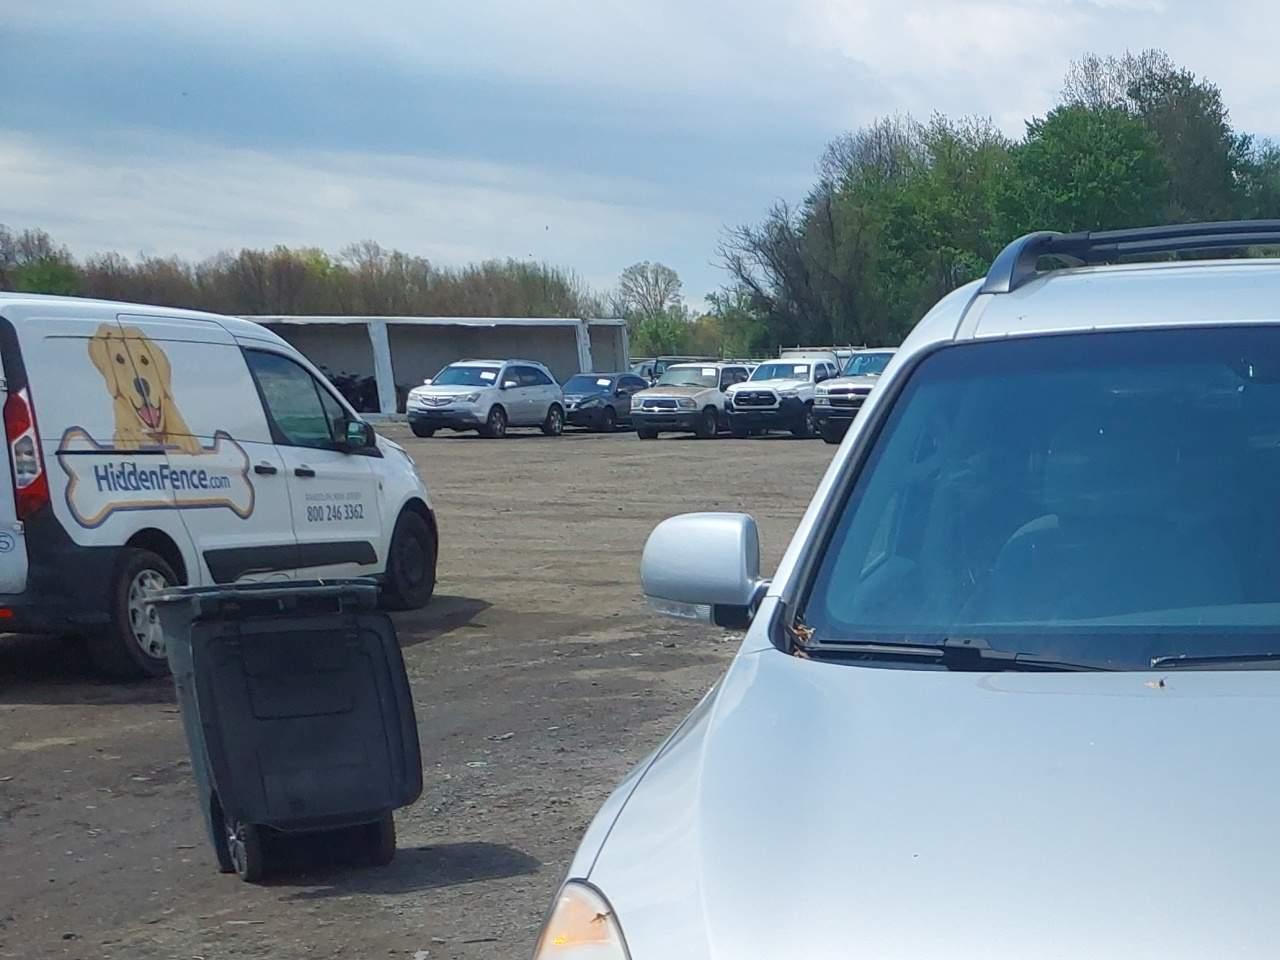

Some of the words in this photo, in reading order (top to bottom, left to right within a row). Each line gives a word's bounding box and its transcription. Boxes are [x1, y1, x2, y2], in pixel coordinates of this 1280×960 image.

[94, 462, 231, 492] HiddenFence.com
[306, 505, 324, 522] 800
[326, 504, 342, 521] 246
[344, 503, 364, 520] 3362
